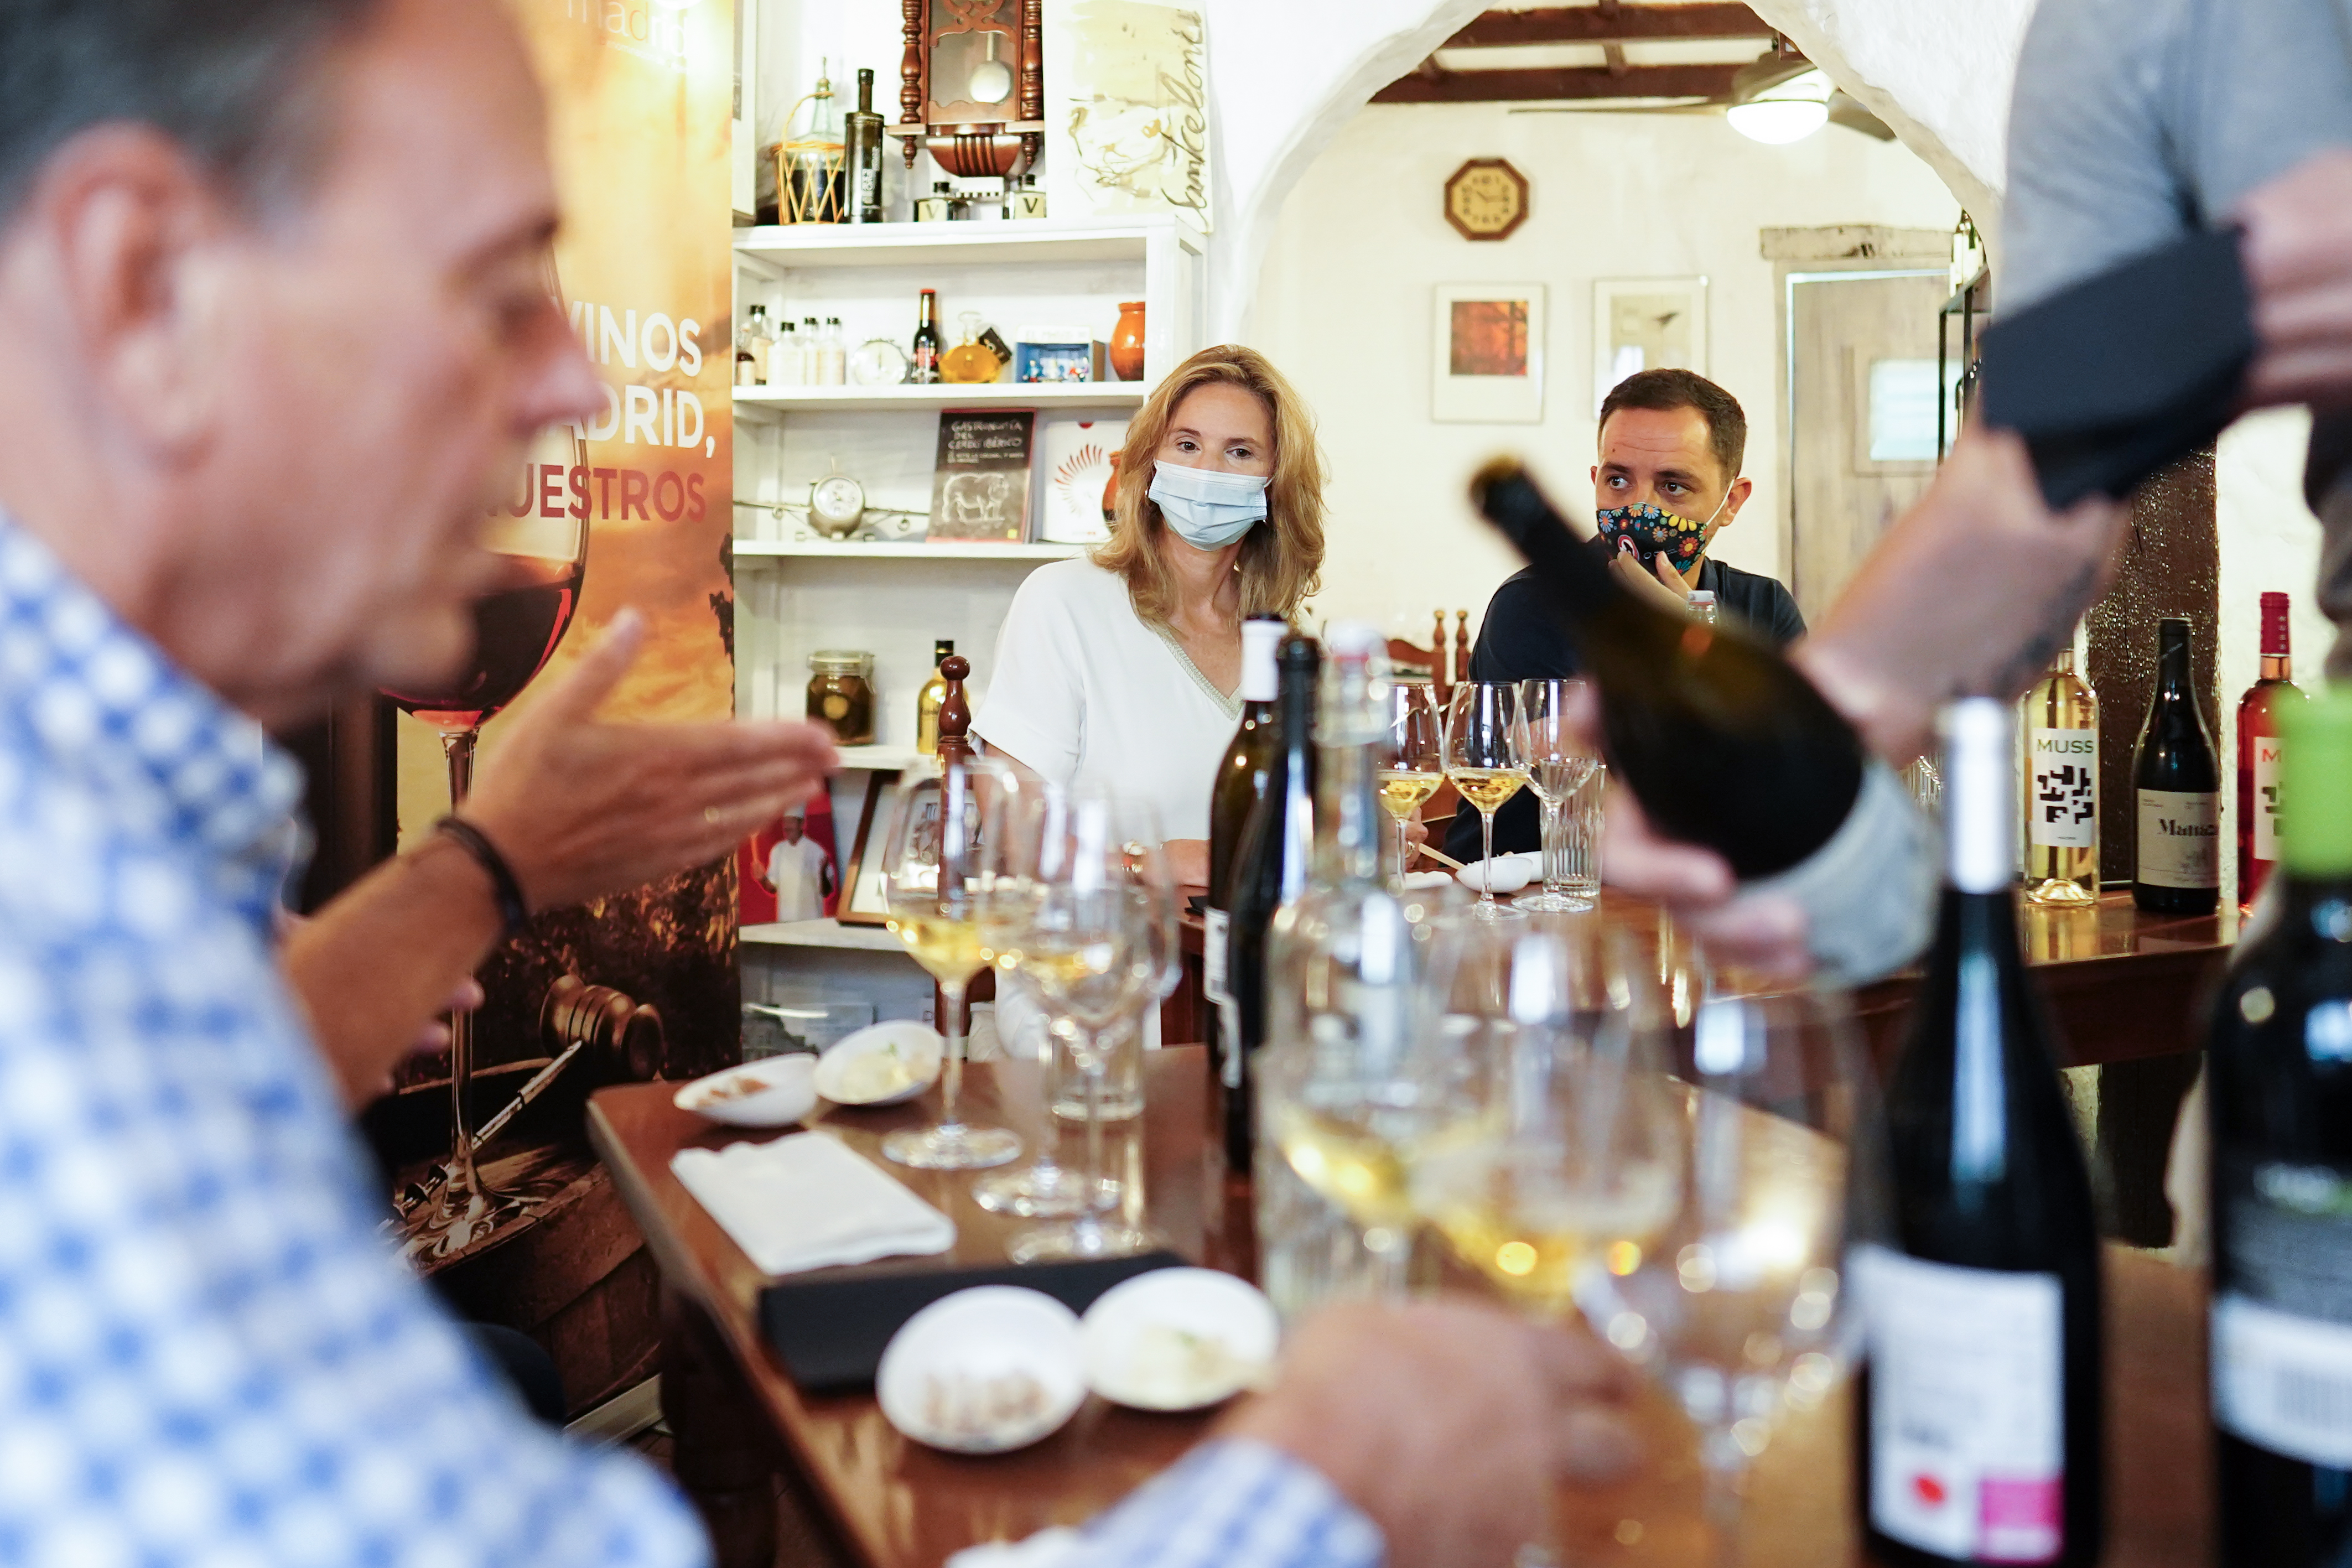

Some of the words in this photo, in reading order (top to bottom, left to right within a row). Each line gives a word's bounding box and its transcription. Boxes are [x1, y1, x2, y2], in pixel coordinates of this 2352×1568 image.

[1024, 198, 1038, 214] V
[488, 463, 707, 523] UESTROS
[2037, 739, 2094, 754] MUSS
